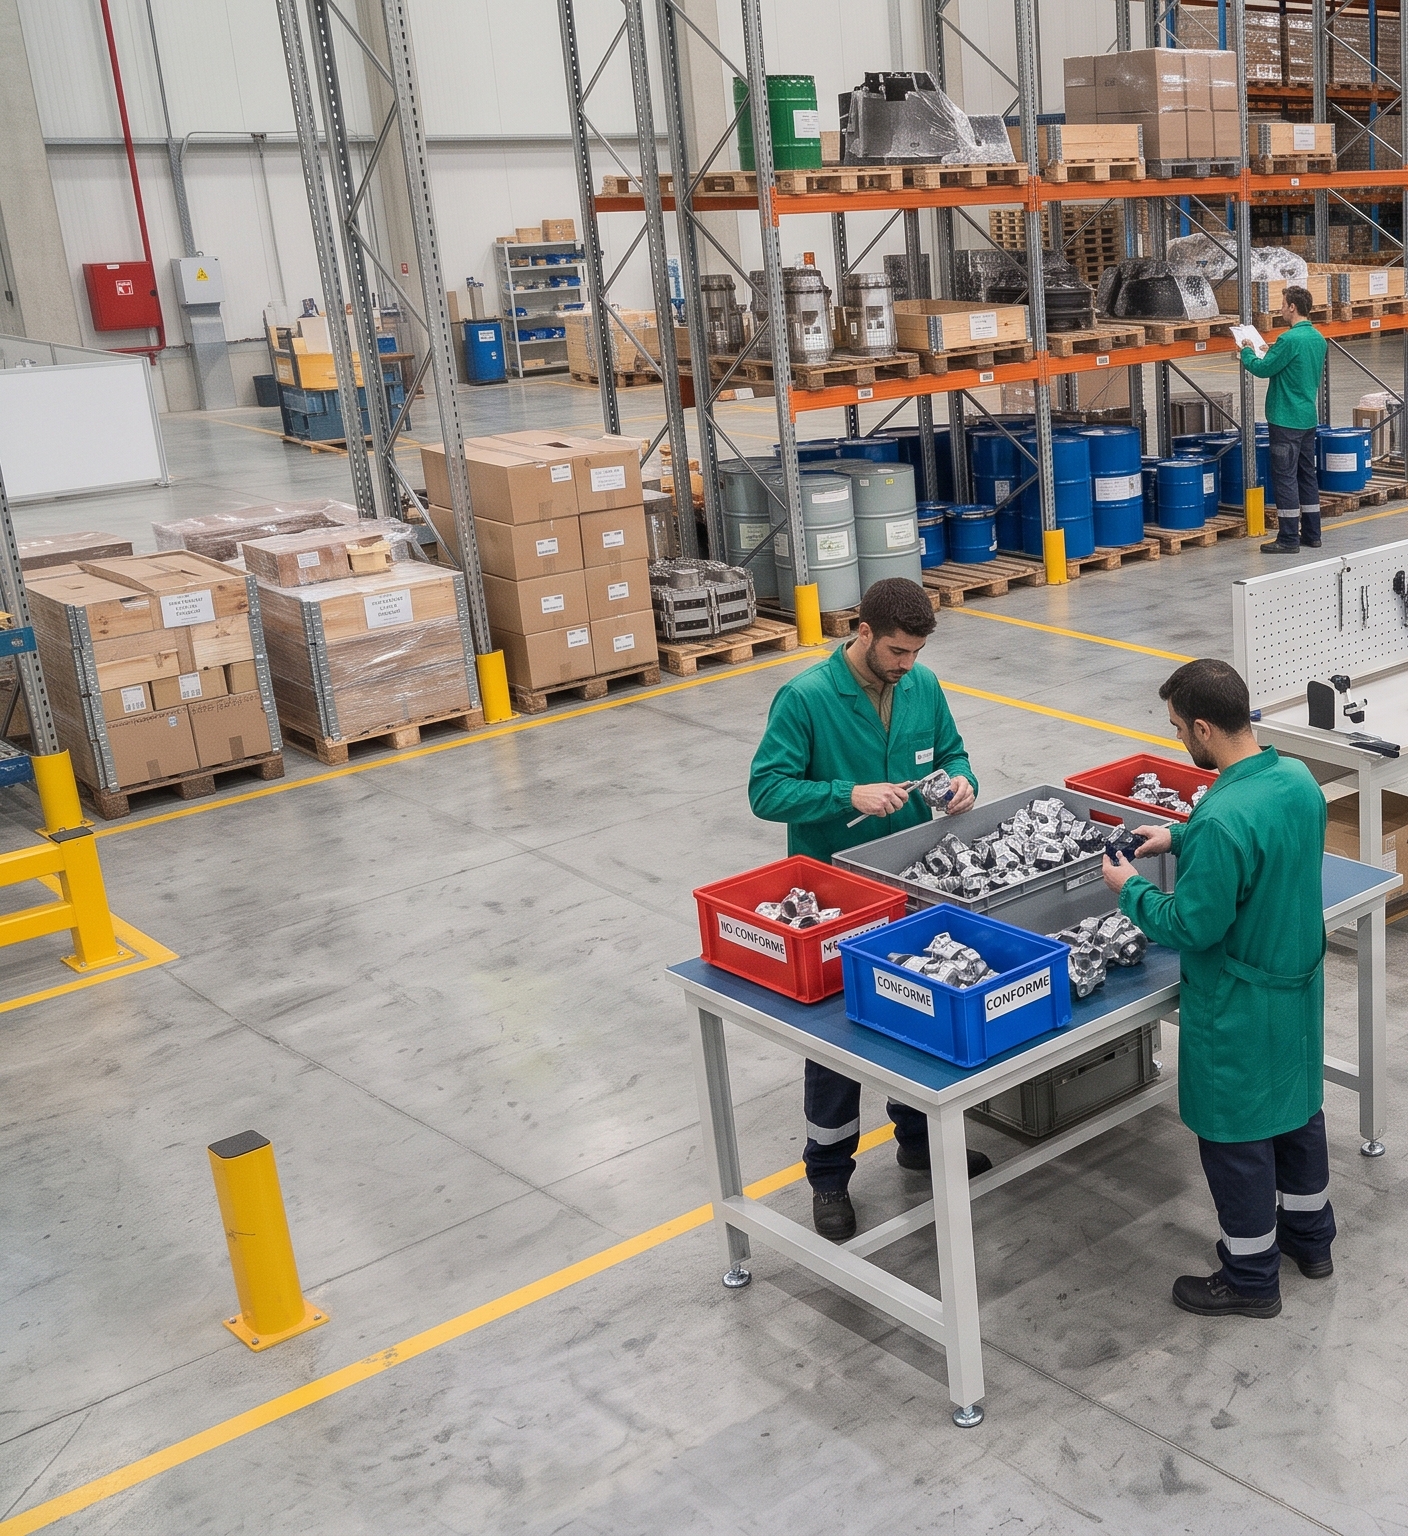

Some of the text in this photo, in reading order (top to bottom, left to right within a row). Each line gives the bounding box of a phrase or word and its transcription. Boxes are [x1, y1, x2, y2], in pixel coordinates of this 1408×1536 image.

[720, 920, 785, 955] NO CONFORME
[877, 975, 932, 1008] CONFORME
[985, 974, 1051, 1012] CONFORME
